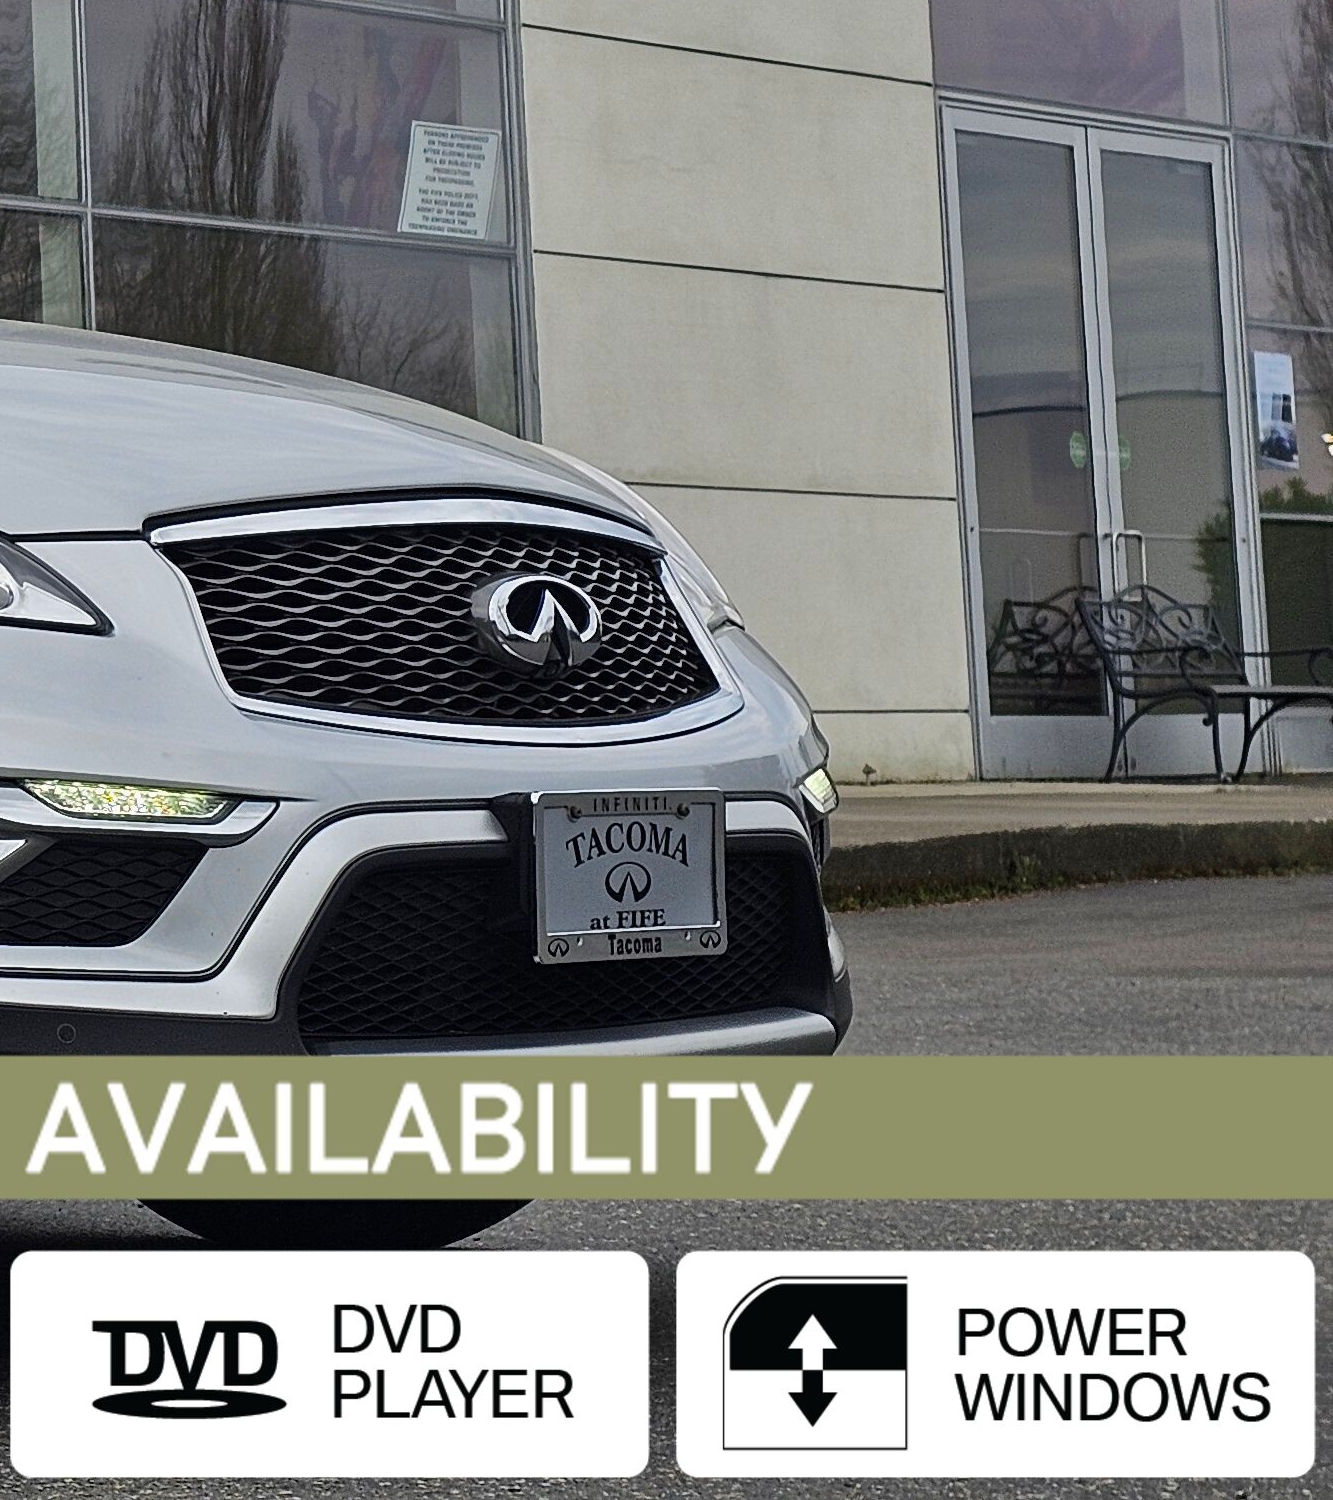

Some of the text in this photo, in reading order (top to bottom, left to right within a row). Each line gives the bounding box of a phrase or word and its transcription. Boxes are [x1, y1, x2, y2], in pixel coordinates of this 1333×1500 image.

[565, 821, 690, 868] TACOMA
[590, 908, 666, 930] at FIFE
[608, 933, 662, 956] Tacoma
